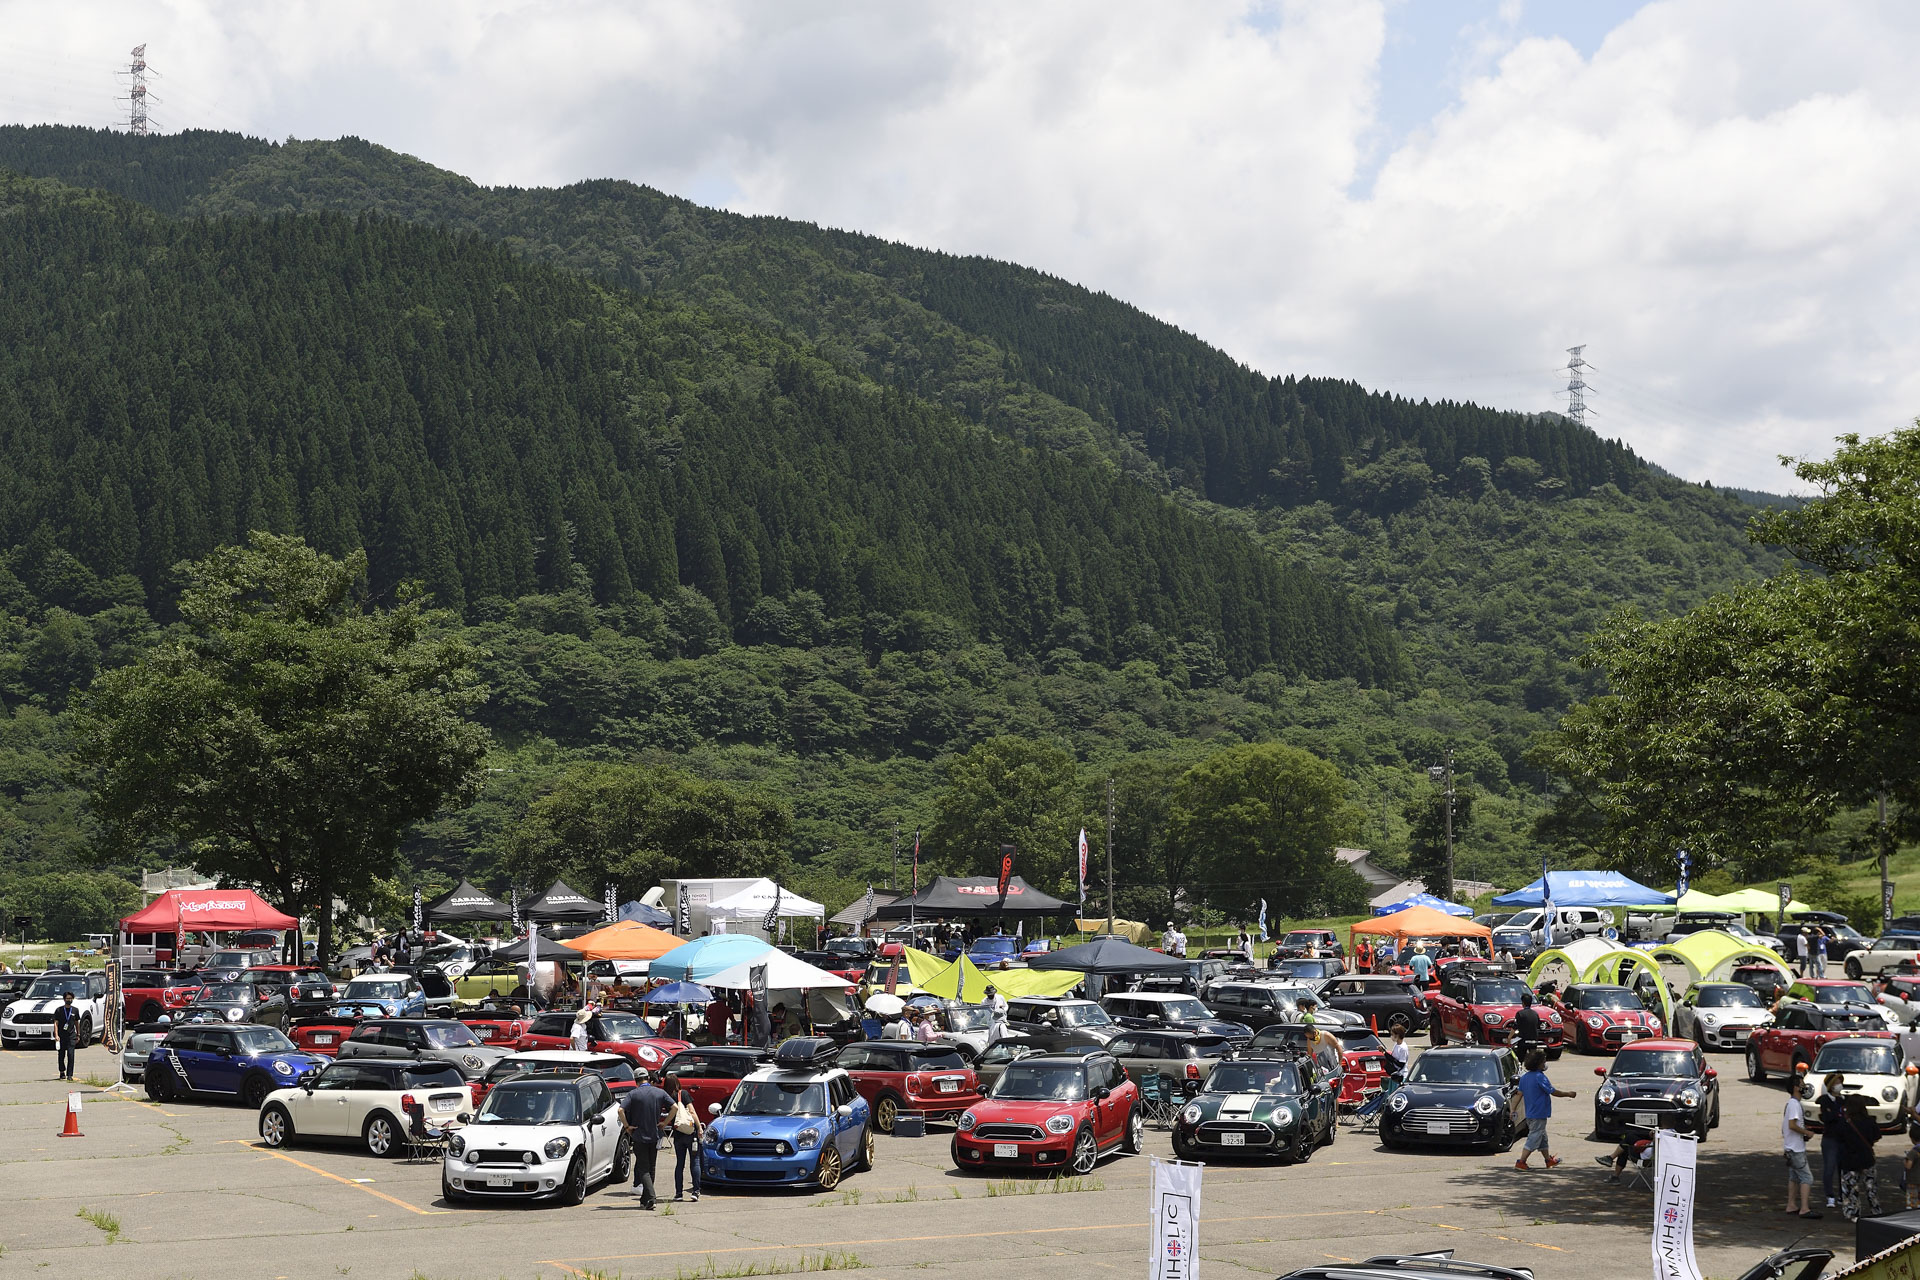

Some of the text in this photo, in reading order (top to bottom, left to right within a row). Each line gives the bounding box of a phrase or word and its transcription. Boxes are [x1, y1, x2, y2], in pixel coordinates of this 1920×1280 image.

[1585, 880, 1628, 888] WORK
[168, 1055, 188, 1077] MINI
[1677, 1198, 1687, 1235] SERVICE
